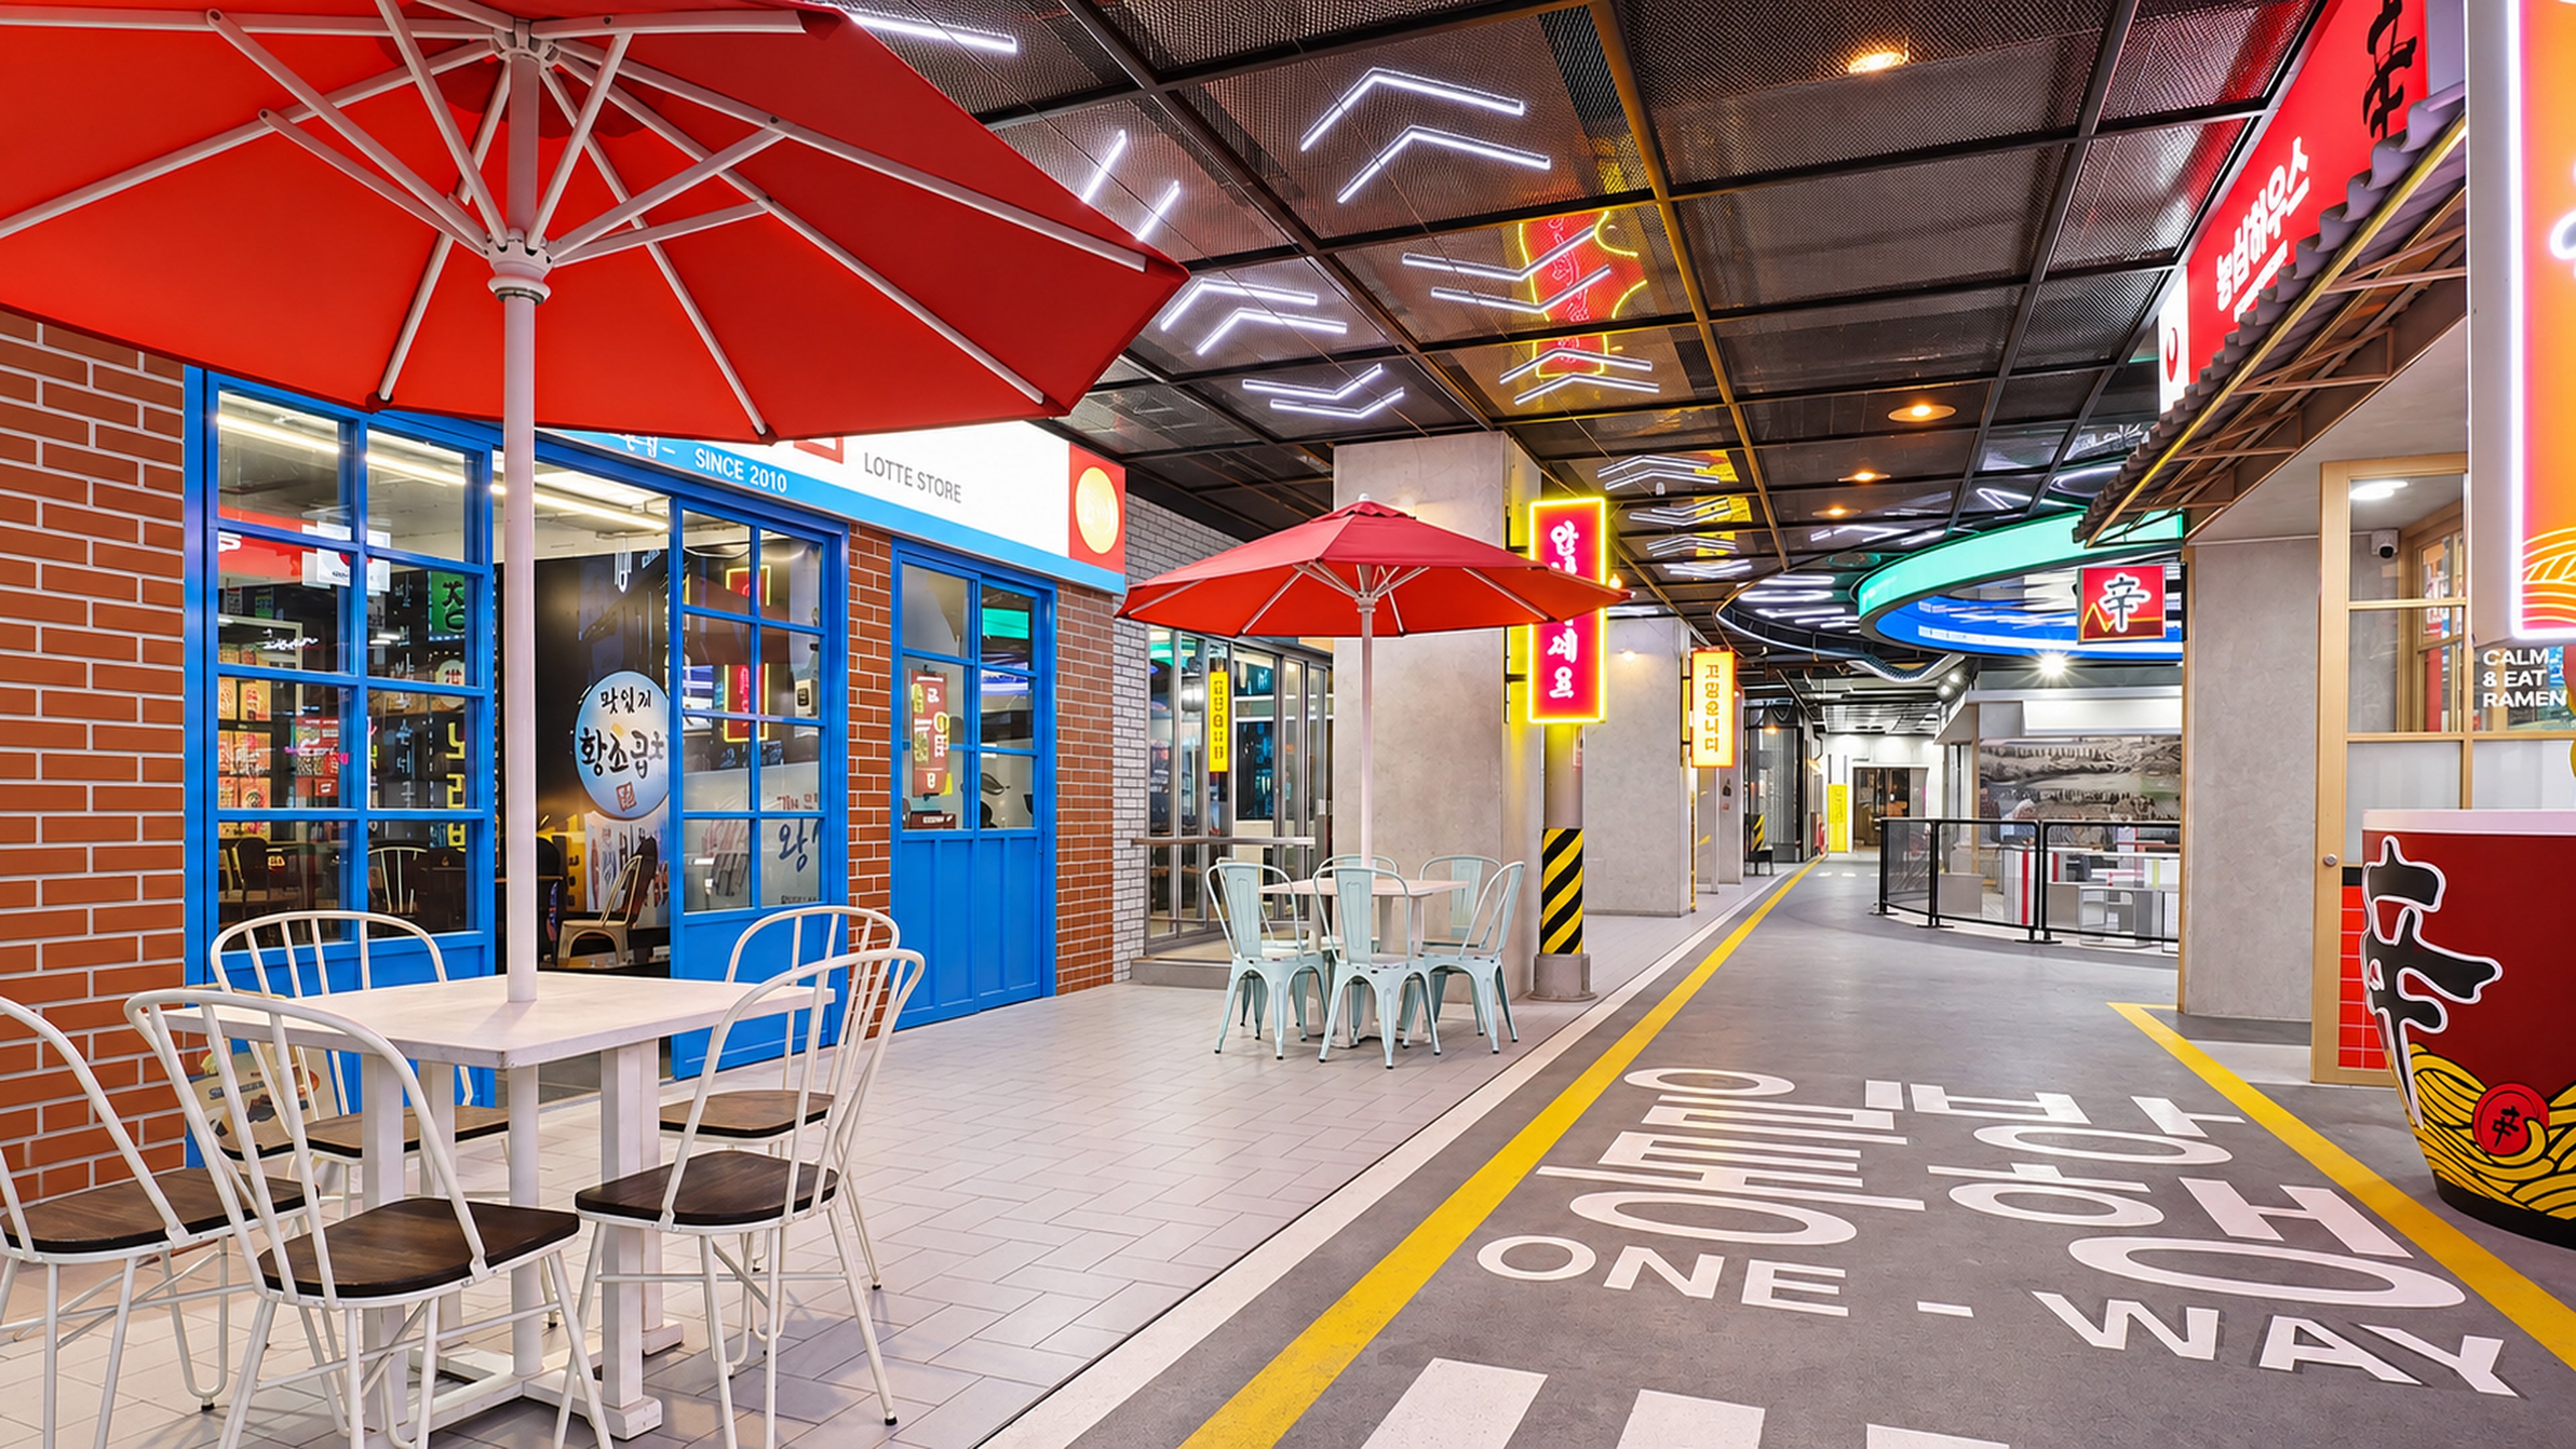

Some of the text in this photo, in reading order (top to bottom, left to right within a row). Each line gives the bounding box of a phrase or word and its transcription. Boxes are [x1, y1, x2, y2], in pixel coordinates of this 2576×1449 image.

[2216, 136, 2310, 311] 농심하우스
[695, 447, 788, 493] SINCE 2010
[864, 451, 962, 504] LOTTE STORE
[1548, 521, 1579, 698] 안세요
[2100, 574, 2149, 631] 辛
[2483, 648, 2548, 665] CALM
[2504, 669, 2547, 688] EAT
[2483, 690, 2567, 708] RAMEN
[779, 818, 820, 872] 왕
[1623, 1068, 2246, 1165] 일방
[1536, 1131, 2467, 1308] 통행
[1477, 1235, 1849, 1318] ONE
[2031, 1291, 2519, 1398] WAY
